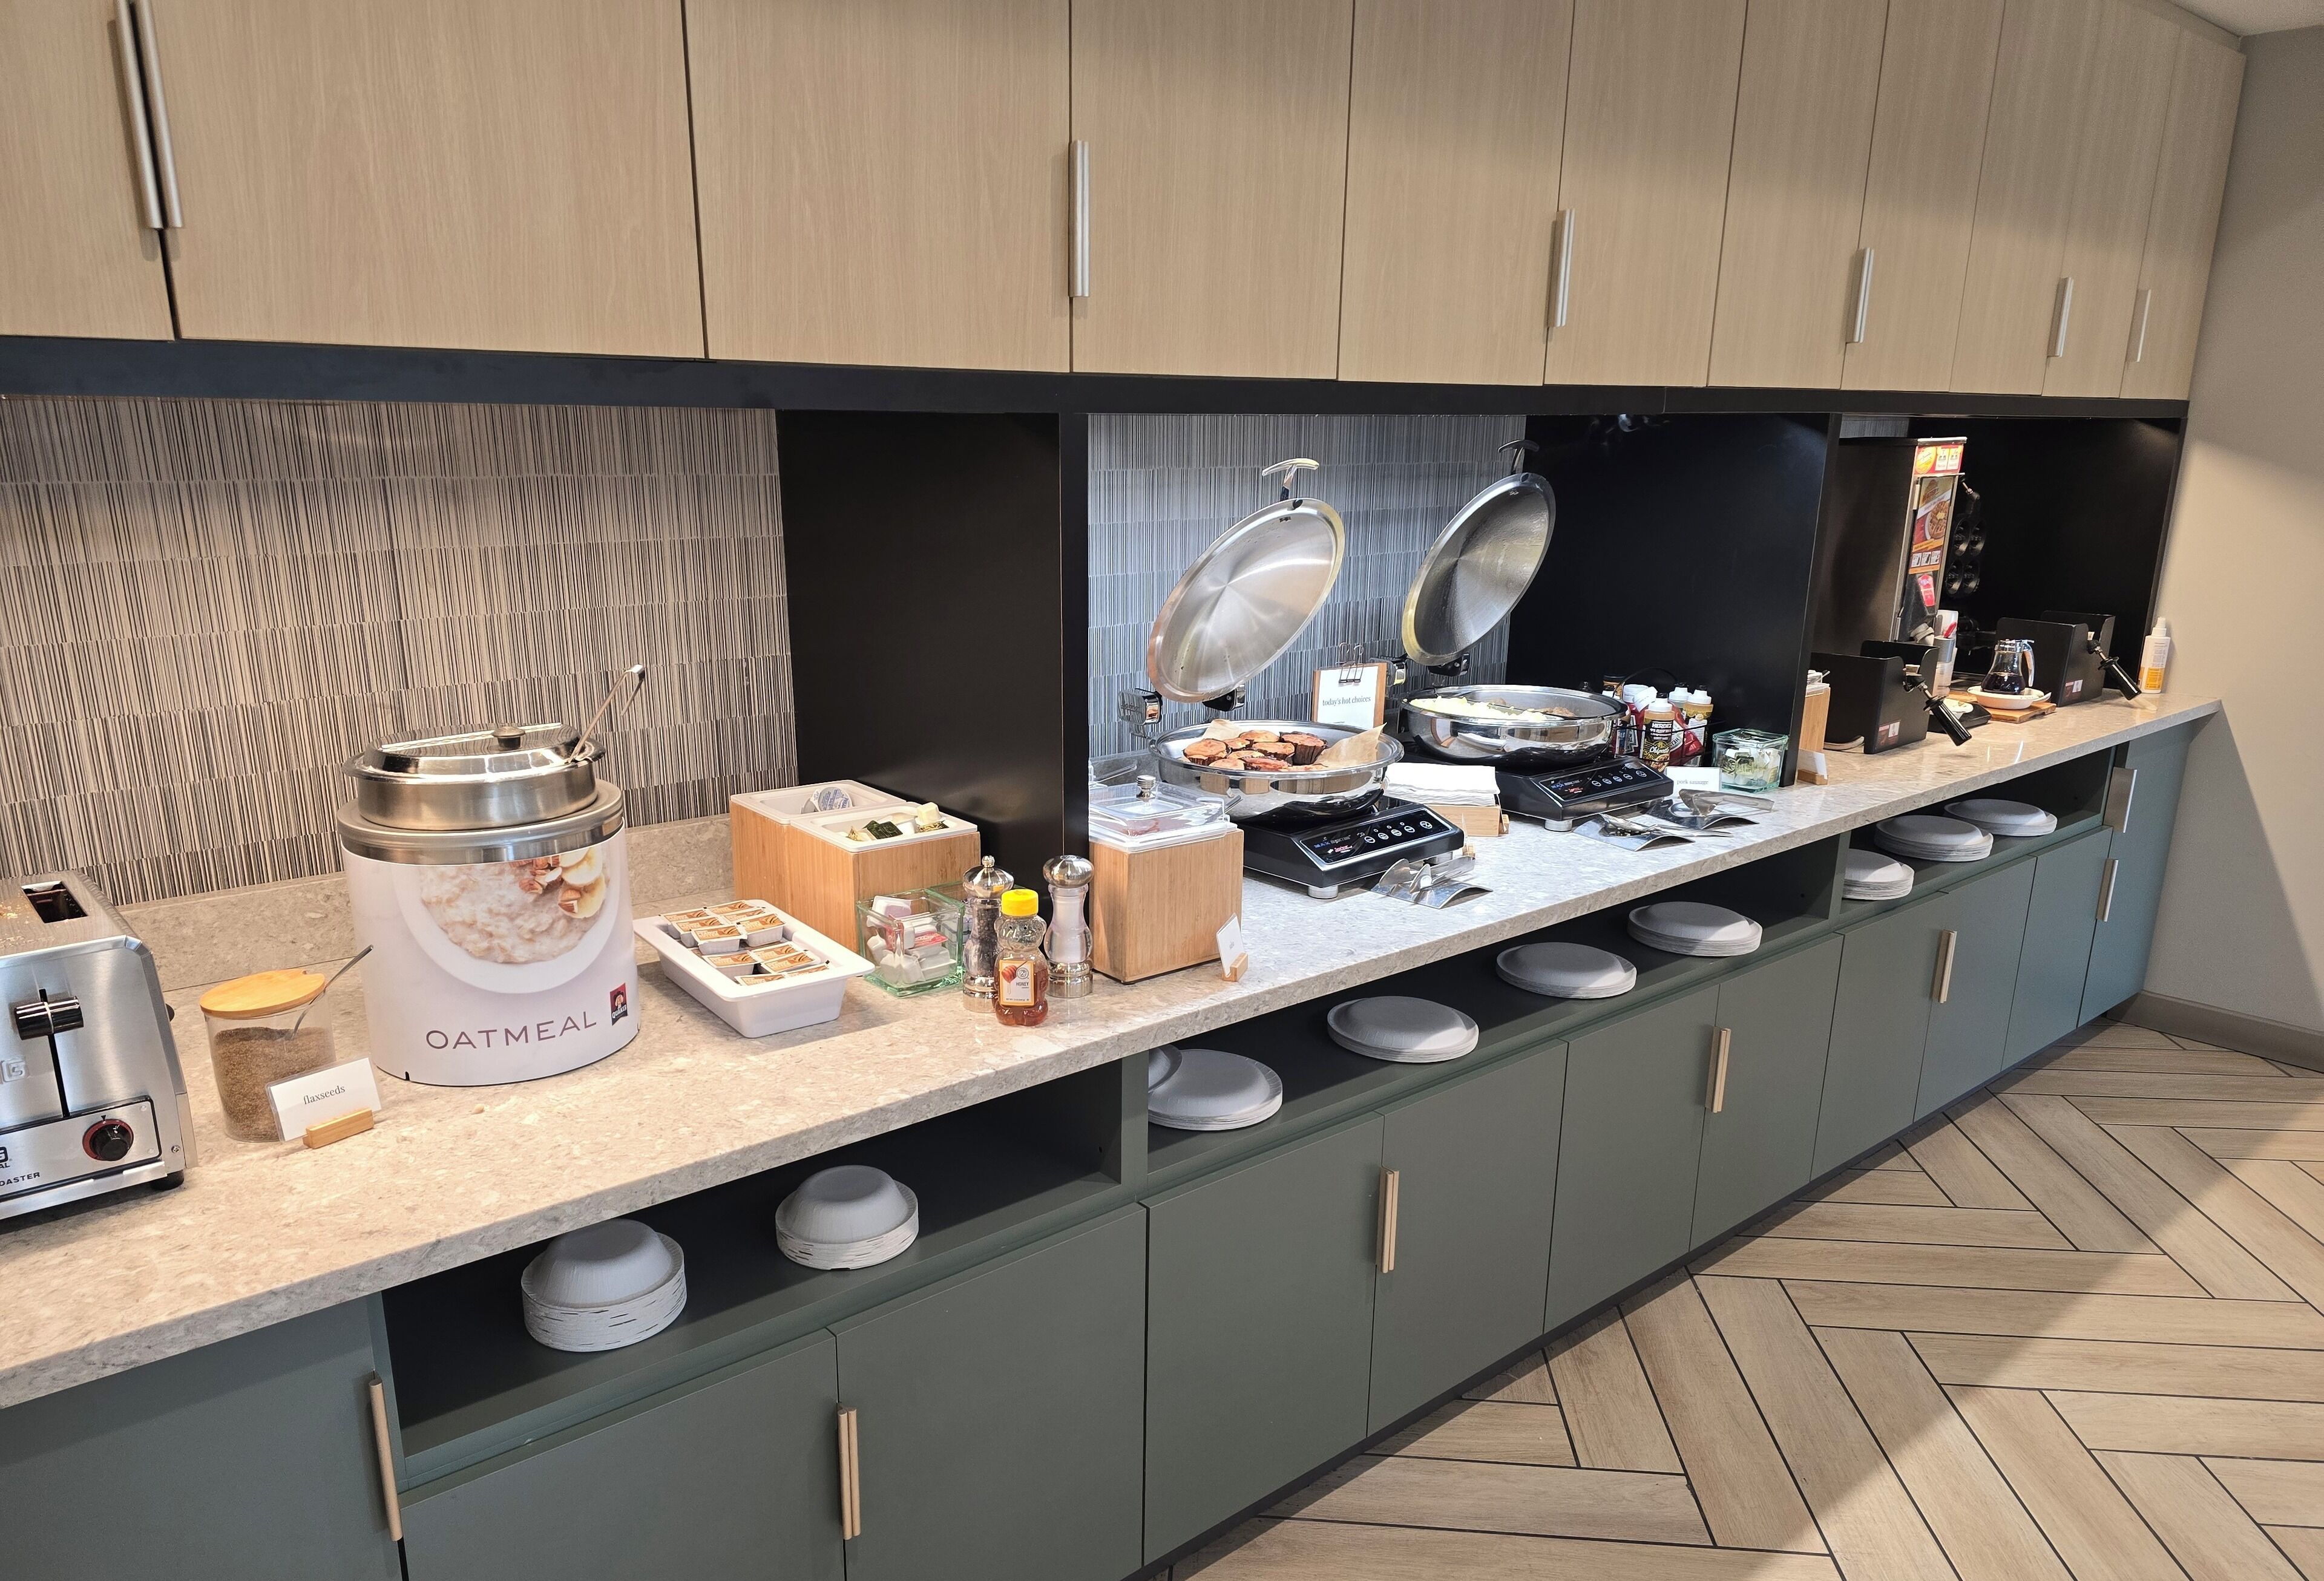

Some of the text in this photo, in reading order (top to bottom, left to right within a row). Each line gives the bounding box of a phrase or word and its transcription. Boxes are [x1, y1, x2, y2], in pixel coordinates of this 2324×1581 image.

[1322, 698, 1341, 707] today's
[426, 1011, 597, 1050] OATMEAL
[303, 1085, 346, 1105] flaxseeds
